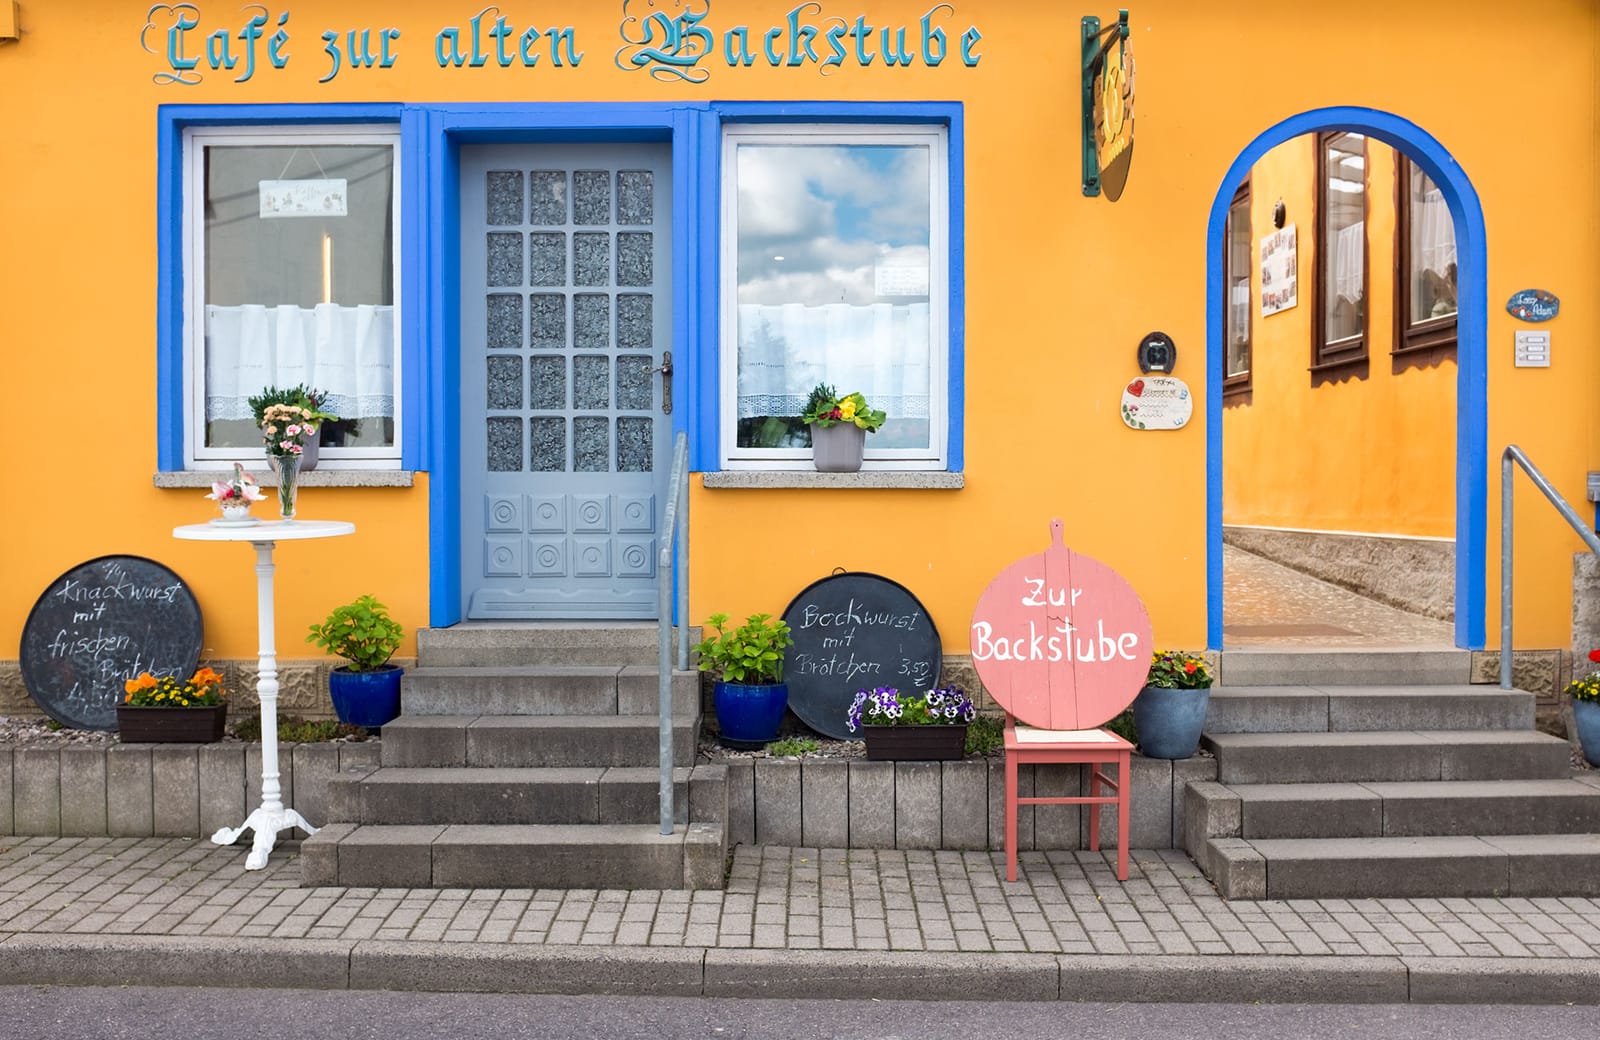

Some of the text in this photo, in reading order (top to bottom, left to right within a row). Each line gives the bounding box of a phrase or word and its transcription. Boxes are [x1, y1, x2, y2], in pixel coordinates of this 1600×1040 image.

[141, 0, 983, 84] Café zur alten Backstube
[55, 571, 182, 603] Knackwurst
[1021, 576, 1083, 607] Zur
[72, 602, 107, 624] mit
[800, 598, 921, 631] Bockwurst
[47, 628, 131, 661] frischen
[822, 626, 856, 649] mit
[971, 616, 1139, 663] Backstube
[795, 652, 881, 684] Brötchen
